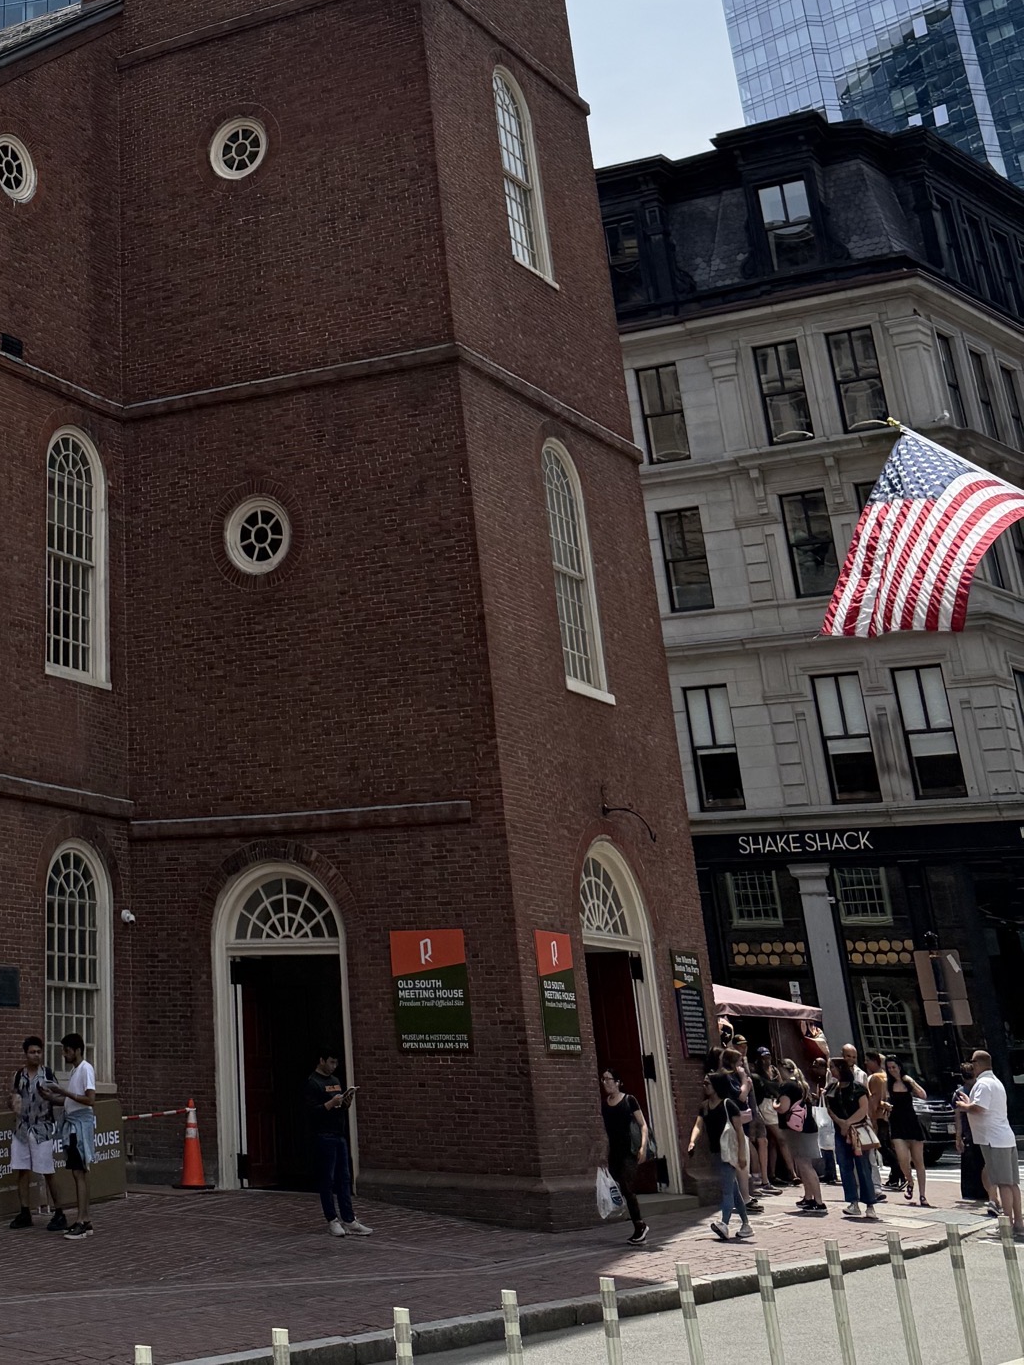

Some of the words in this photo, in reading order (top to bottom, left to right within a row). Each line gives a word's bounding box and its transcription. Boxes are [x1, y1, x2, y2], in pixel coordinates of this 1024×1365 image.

[738, 834, 802, 854] SHAKE
[805, 831, 874, 852] SHACK
[397, 980, 413, 988] OLD
[415, 979, 442, 988] SOUTH
[543, 980, 552, 989] OLD
[552, 981, 565, 990] SOUTH
[398, 989, 435, 999] MEETING
[436, 989, 464, 998] HOUSE
[544, 991, 562, 1000] MEETING
[562, 992, 576, 1001] HOUSE
[435, 999, 454, 1008] Official
[110, 1148, 120, 1158] Site
